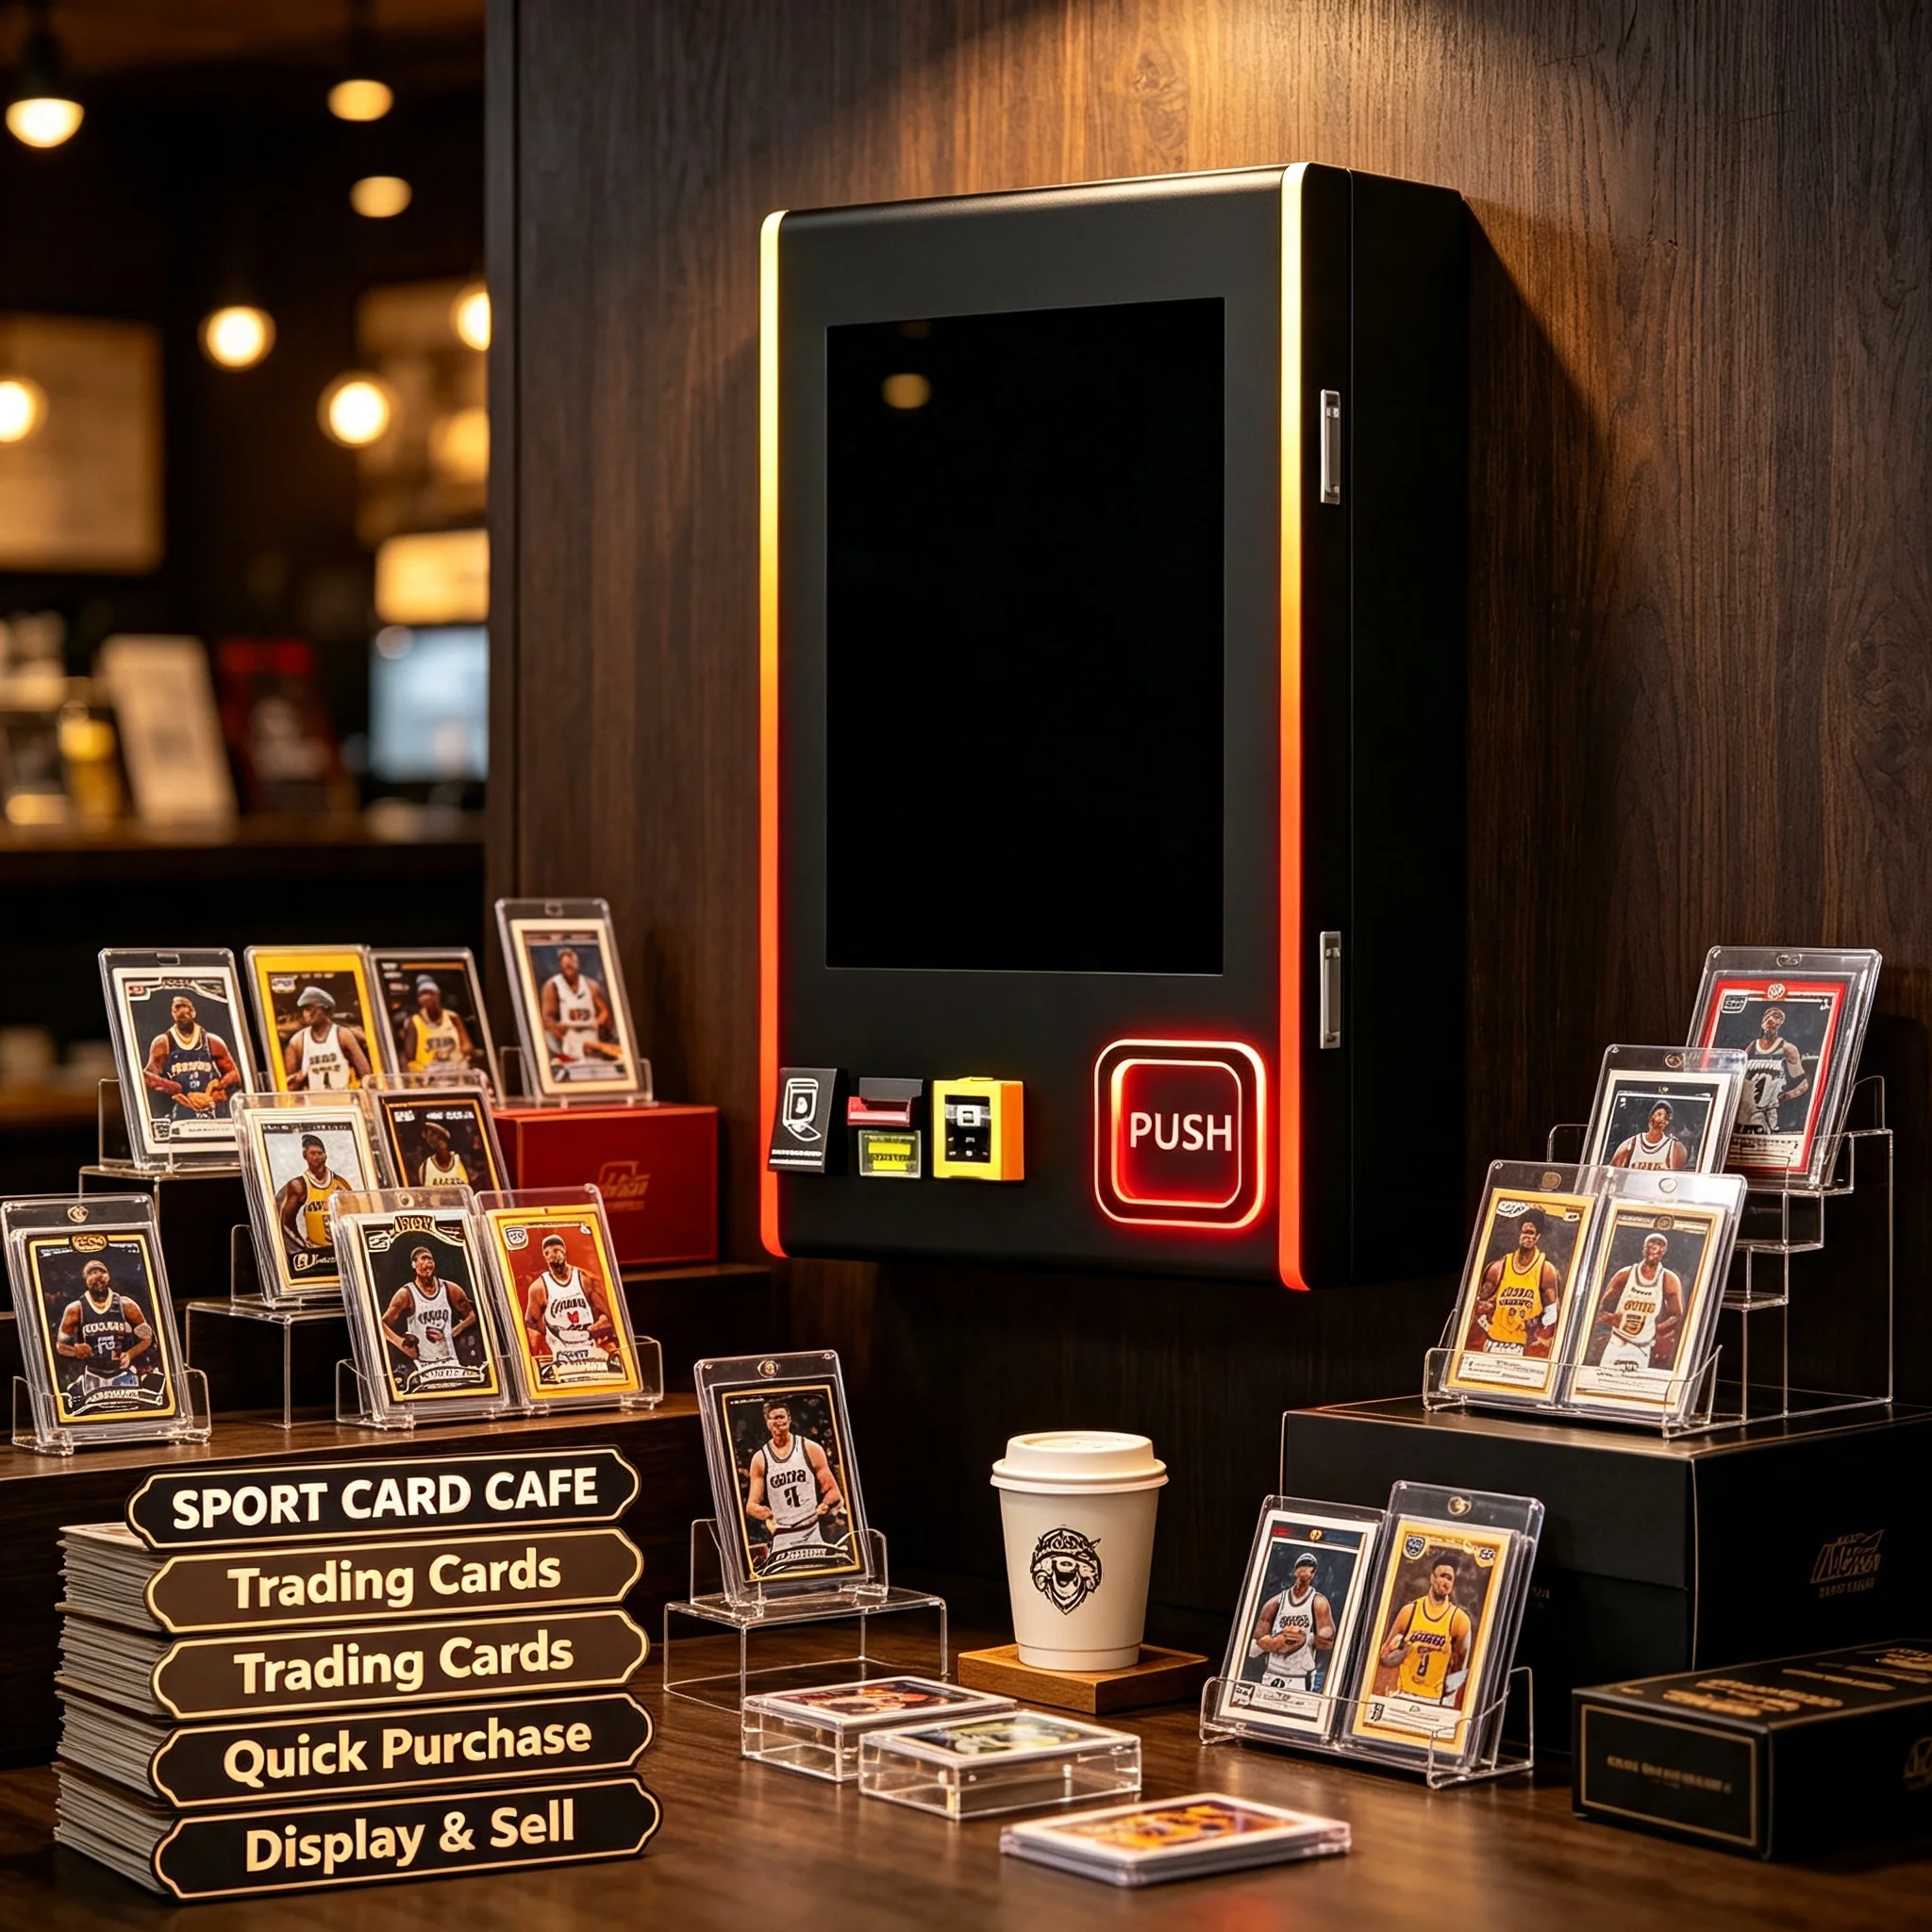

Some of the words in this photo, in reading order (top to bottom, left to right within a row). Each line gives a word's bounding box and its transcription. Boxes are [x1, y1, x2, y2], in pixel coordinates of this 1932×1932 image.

[1130, 1111, 1232, 1152] PUSH
[173, 1483, 327, 1529] SPORT
[341, 1474, 471, 1519] CARD
[485, 1467, 599, 1511] CAFE
[227, 1559, 415, 1608] Trading
[427, 1547, 561, 1594] Cards
[233, 1644, 424, 1693] Trading
[439, 1630, 574, 1678] Cards
[223, 1729, 368, 1787] Quick
[382, 1717, 592, 1770] Purchase
[245, 1818, 425, 1874] Display
[440, 1811, 475, 1852] &
[490, 1799, 575, 1846] Sell
